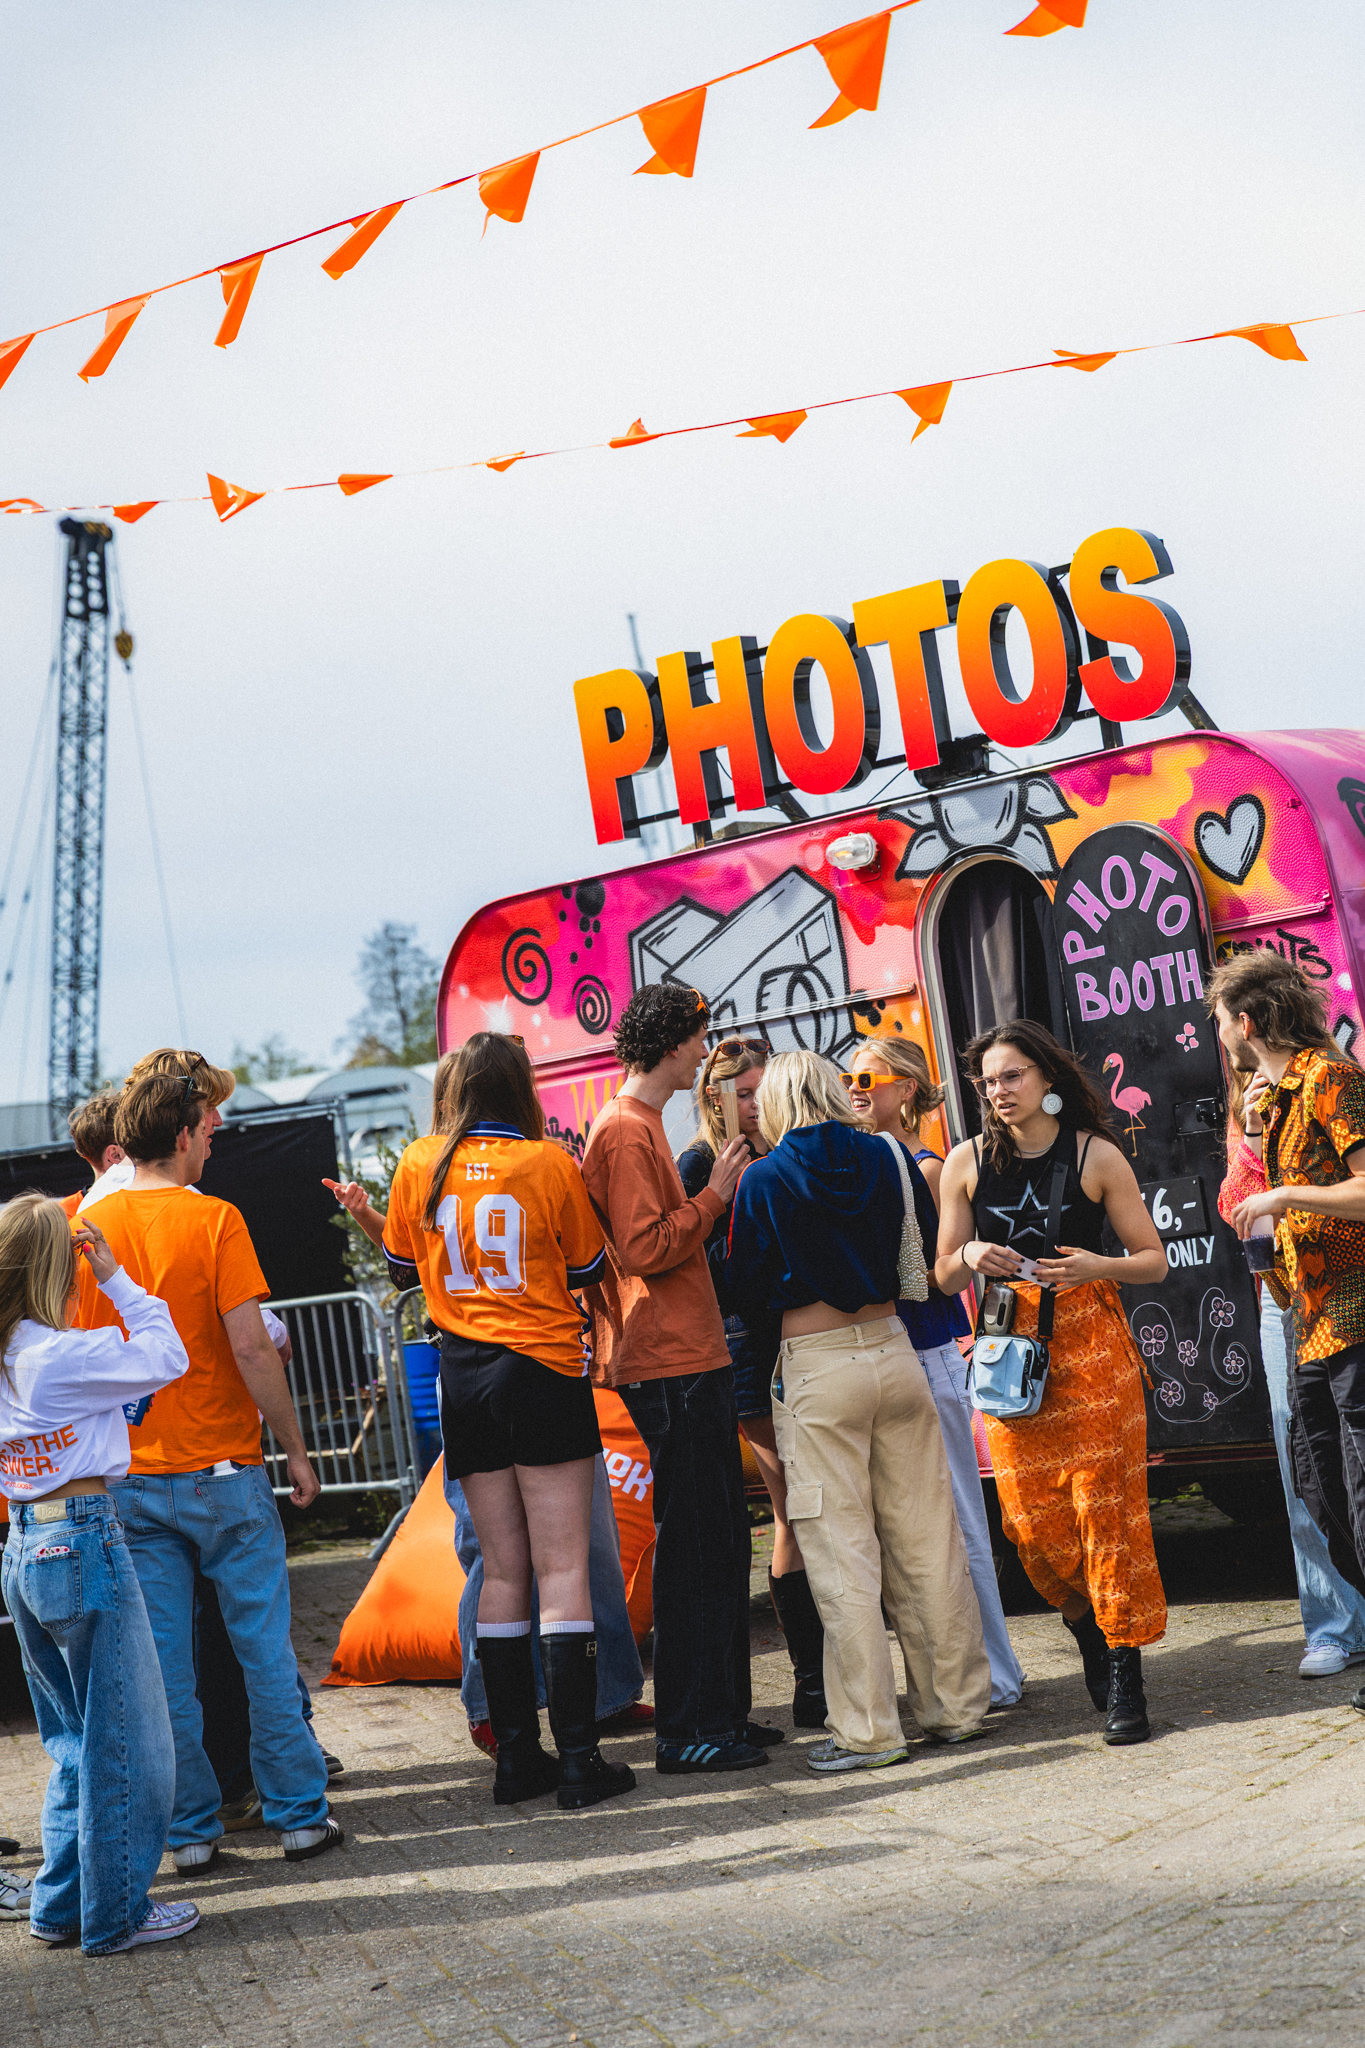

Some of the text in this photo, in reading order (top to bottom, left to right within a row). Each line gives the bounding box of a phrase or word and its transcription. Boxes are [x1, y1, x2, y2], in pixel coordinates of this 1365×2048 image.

[573, 527, 1186, 845] PHOTOS
[1062, 850, 1191, 965] PHOTO
[1075, 949, 1204, 1022] BOOTH
[465, 1163, 496, 1181] EST.
[435, 1194, 527, 1297] 19
[1166, 1235, 1215, 1268] ONLY
[0, 1454, 60, 1477] SWER.
[27, 1423, 78, 1455] THE
